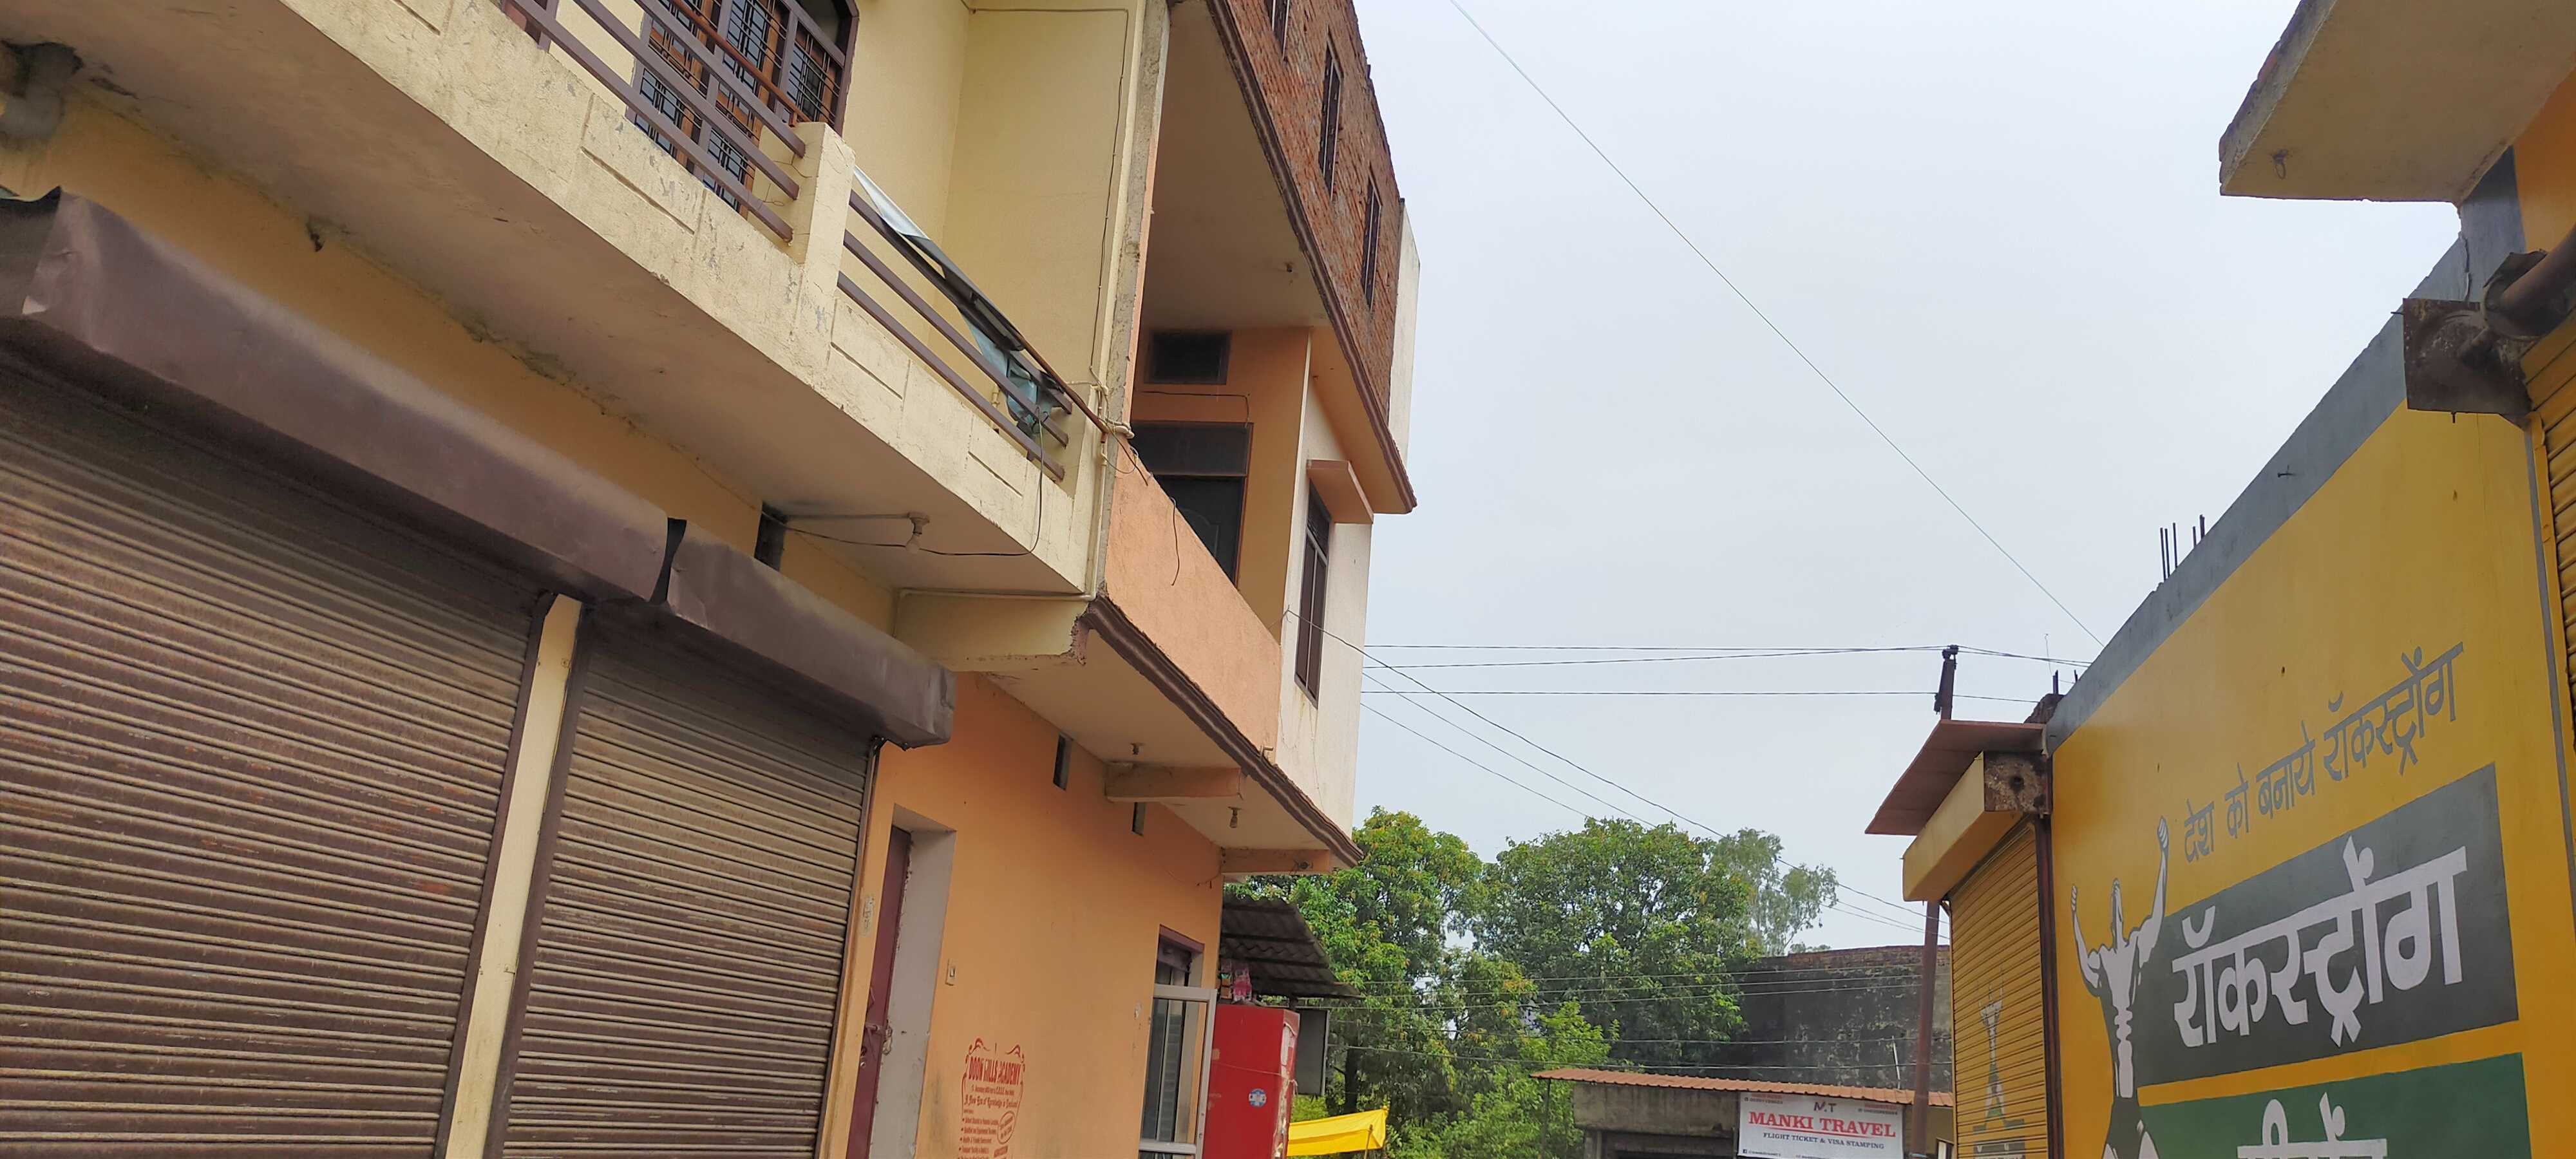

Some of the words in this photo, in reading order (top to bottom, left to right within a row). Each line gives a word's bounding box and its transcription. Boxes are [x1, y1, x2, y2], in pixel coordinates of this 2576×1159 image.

[2184, 798, 2215, 863] देश
[2224, 762, 2249, 839] को
[2255, 720, 2316, 819] बनाये
[1748, 1111, 1814, 1129] MANKI
[1819, 1117, 1897, 1138] TRAVEL
[1763, 1132, 1790, 1141] FLIGHT
[1791, 1135, 1818, 1144] TICKET
[1846, 1140, 1885, 1150] STAMPING
